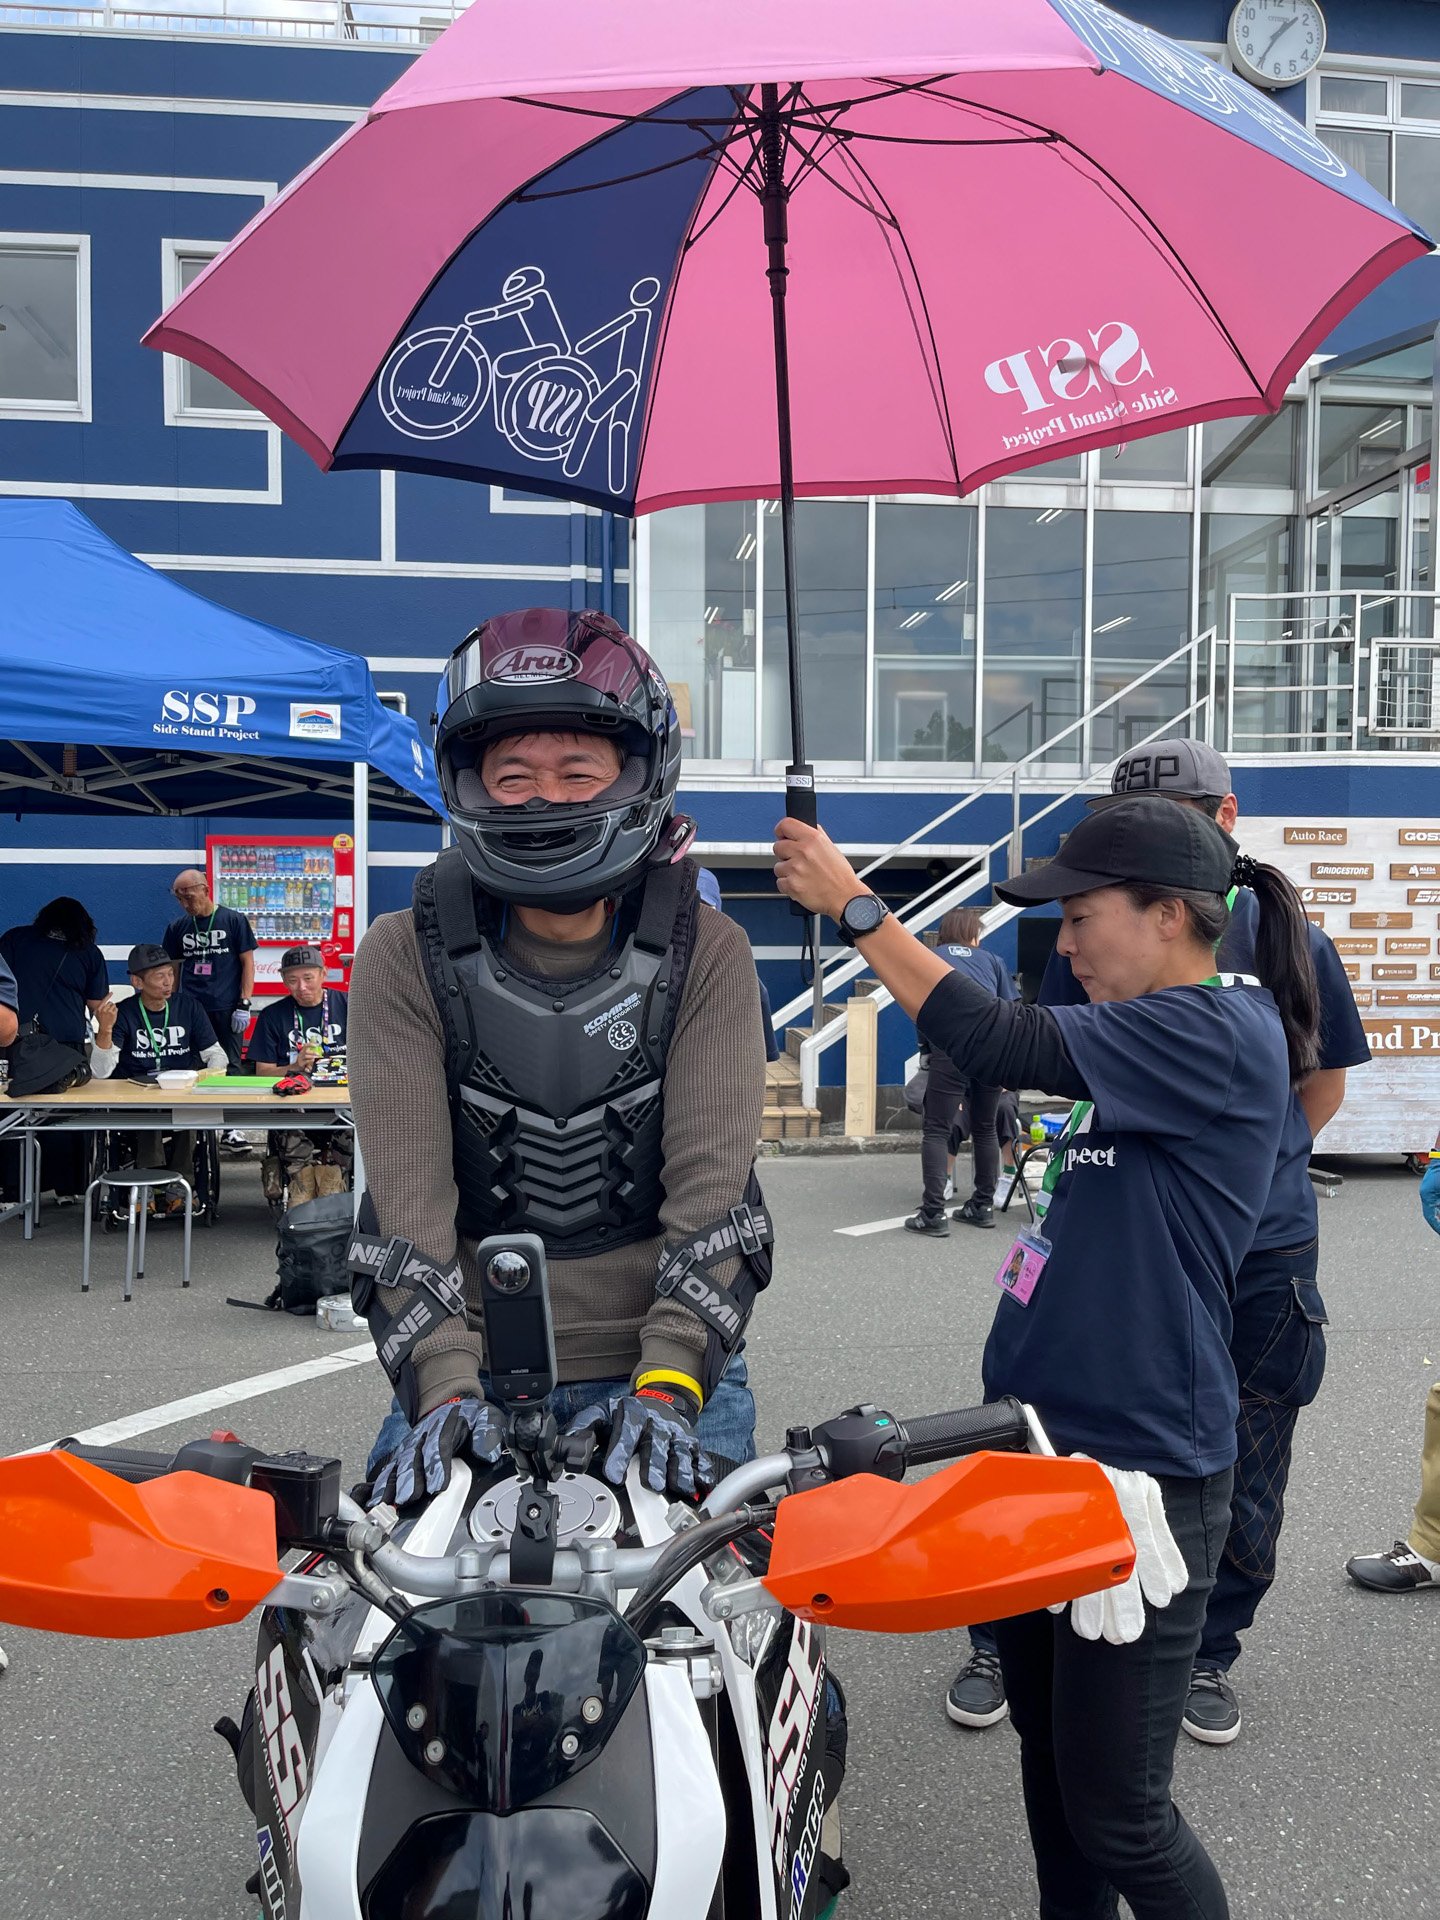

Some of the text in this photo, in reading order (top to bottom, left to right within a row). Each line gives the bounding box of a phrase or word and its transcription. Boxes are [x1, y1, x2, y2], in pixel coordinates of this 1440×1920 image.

[1245, 8, 1256, 20] 10
[1302, 13, 1309, 26] 2
[1242, 25, 1249, 38] 9
[1306, 32, 1313, 44] 3
[1246, 44, 1254, 56] 8
[1301, 49, 1309, 61] 4
[1274, 62, 1281, 75] 6
[1289, 60, 1296, 72] 5
[492, 650, 569, 676] Arai
[162, 690, 256, 726] SSP
[153, 723, 260, 741] Side Stand Project
[1115, 756, 1180, 793] SSP
[1290, 830, 1343, 841] Auto Race
[1404, 832, 1440, 841] GOS
[1317, 865, 1370, 875] BRIDGESTONE
[1317, 892, 1352, 902] SDG
[182, 929, 227, 950] SSP
[583, 992, 639, 1033] KOMINE
[588, 1022, 607, 1037] SAFETY
[136, 1026, 186, 1050] SSP
[168, 1046, 191, 1057] Project
[785, 1753, 808, 1833] STAND
[805, 1652, 827, 1750] PROJECT
